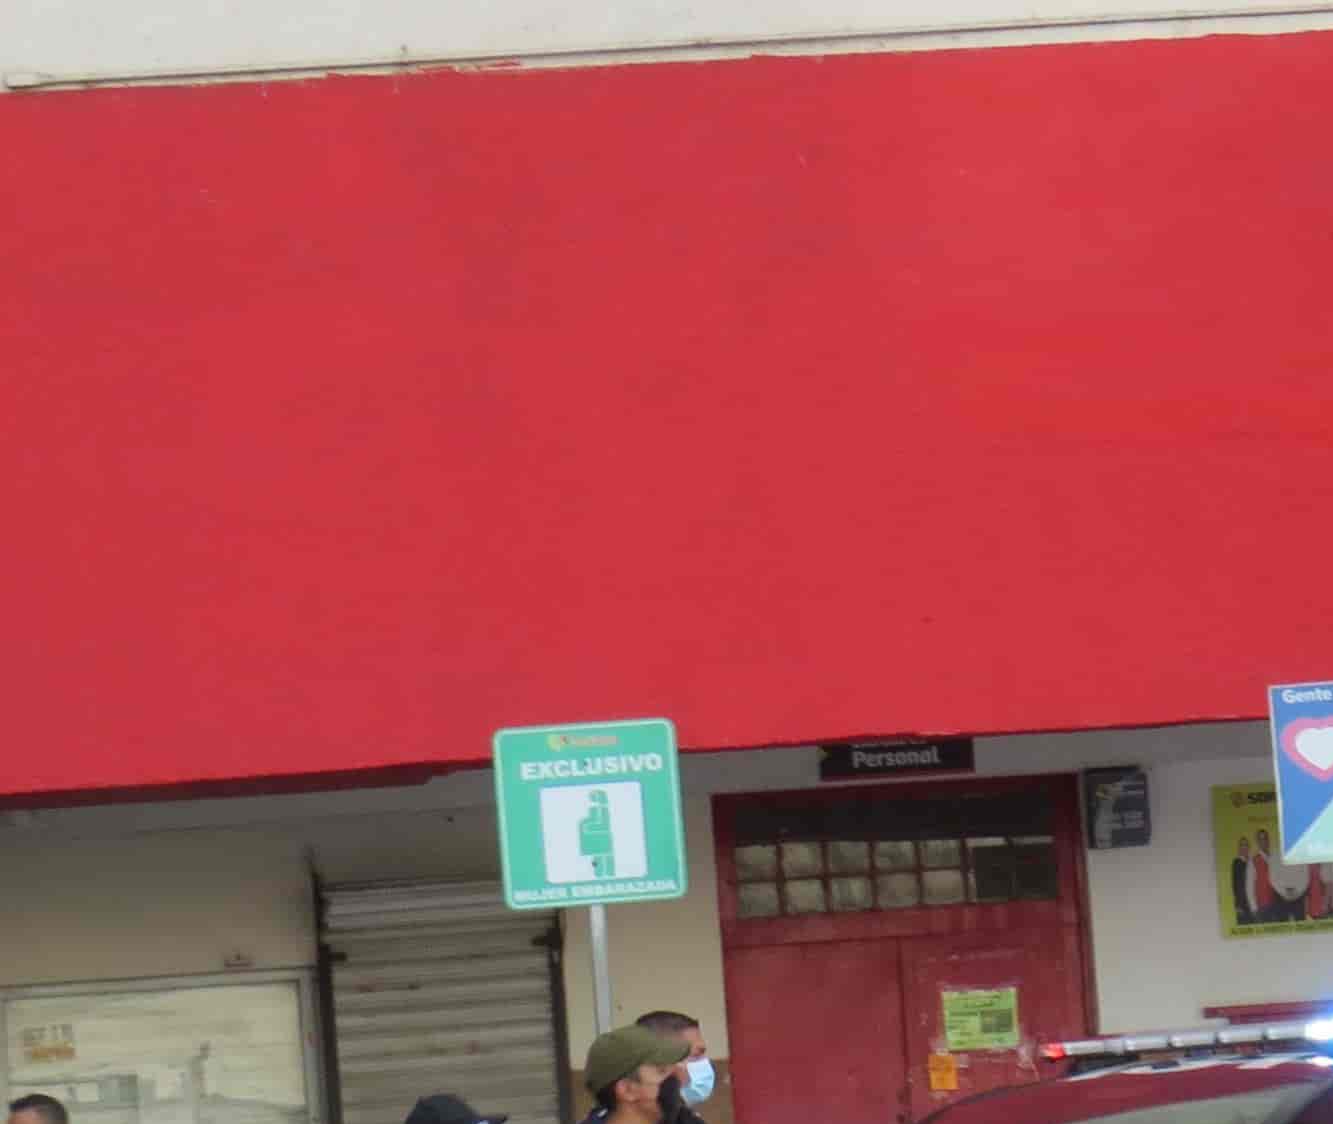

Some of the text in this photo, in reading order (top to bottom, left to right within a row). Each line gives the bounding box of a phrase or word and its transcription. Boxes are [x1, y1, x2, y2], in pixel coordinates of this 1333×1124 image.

[1281, 689, 1333, 704] Gente
[519, 752, 664, 781] EXCLUSIVO
[852, 745, 941, 768] Personal
